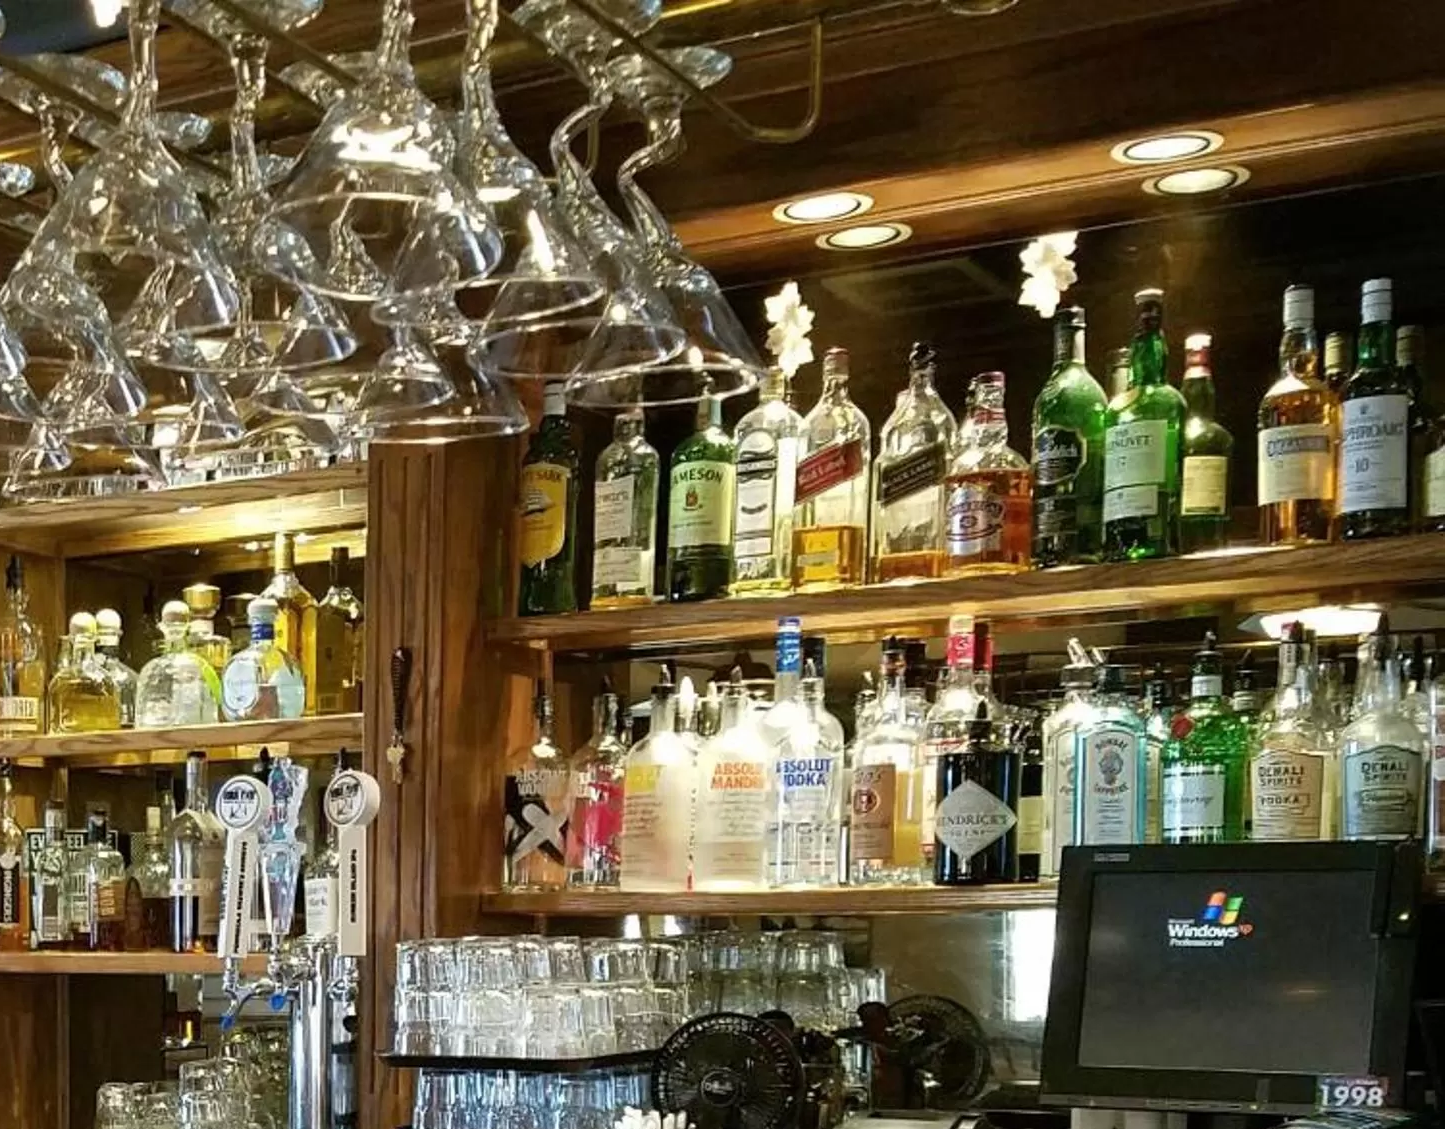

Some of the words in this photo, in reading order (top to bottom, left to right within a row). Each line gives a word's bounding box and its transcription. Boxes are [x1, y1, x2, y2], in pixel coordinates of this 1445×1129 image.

[673, 467, 725, 485] AMESON
[776, 759, 831, 774] ABSOLUT
[1168, 924, 1239, 938] Windows
[1320, 1084, 1384, 1107] 1998
